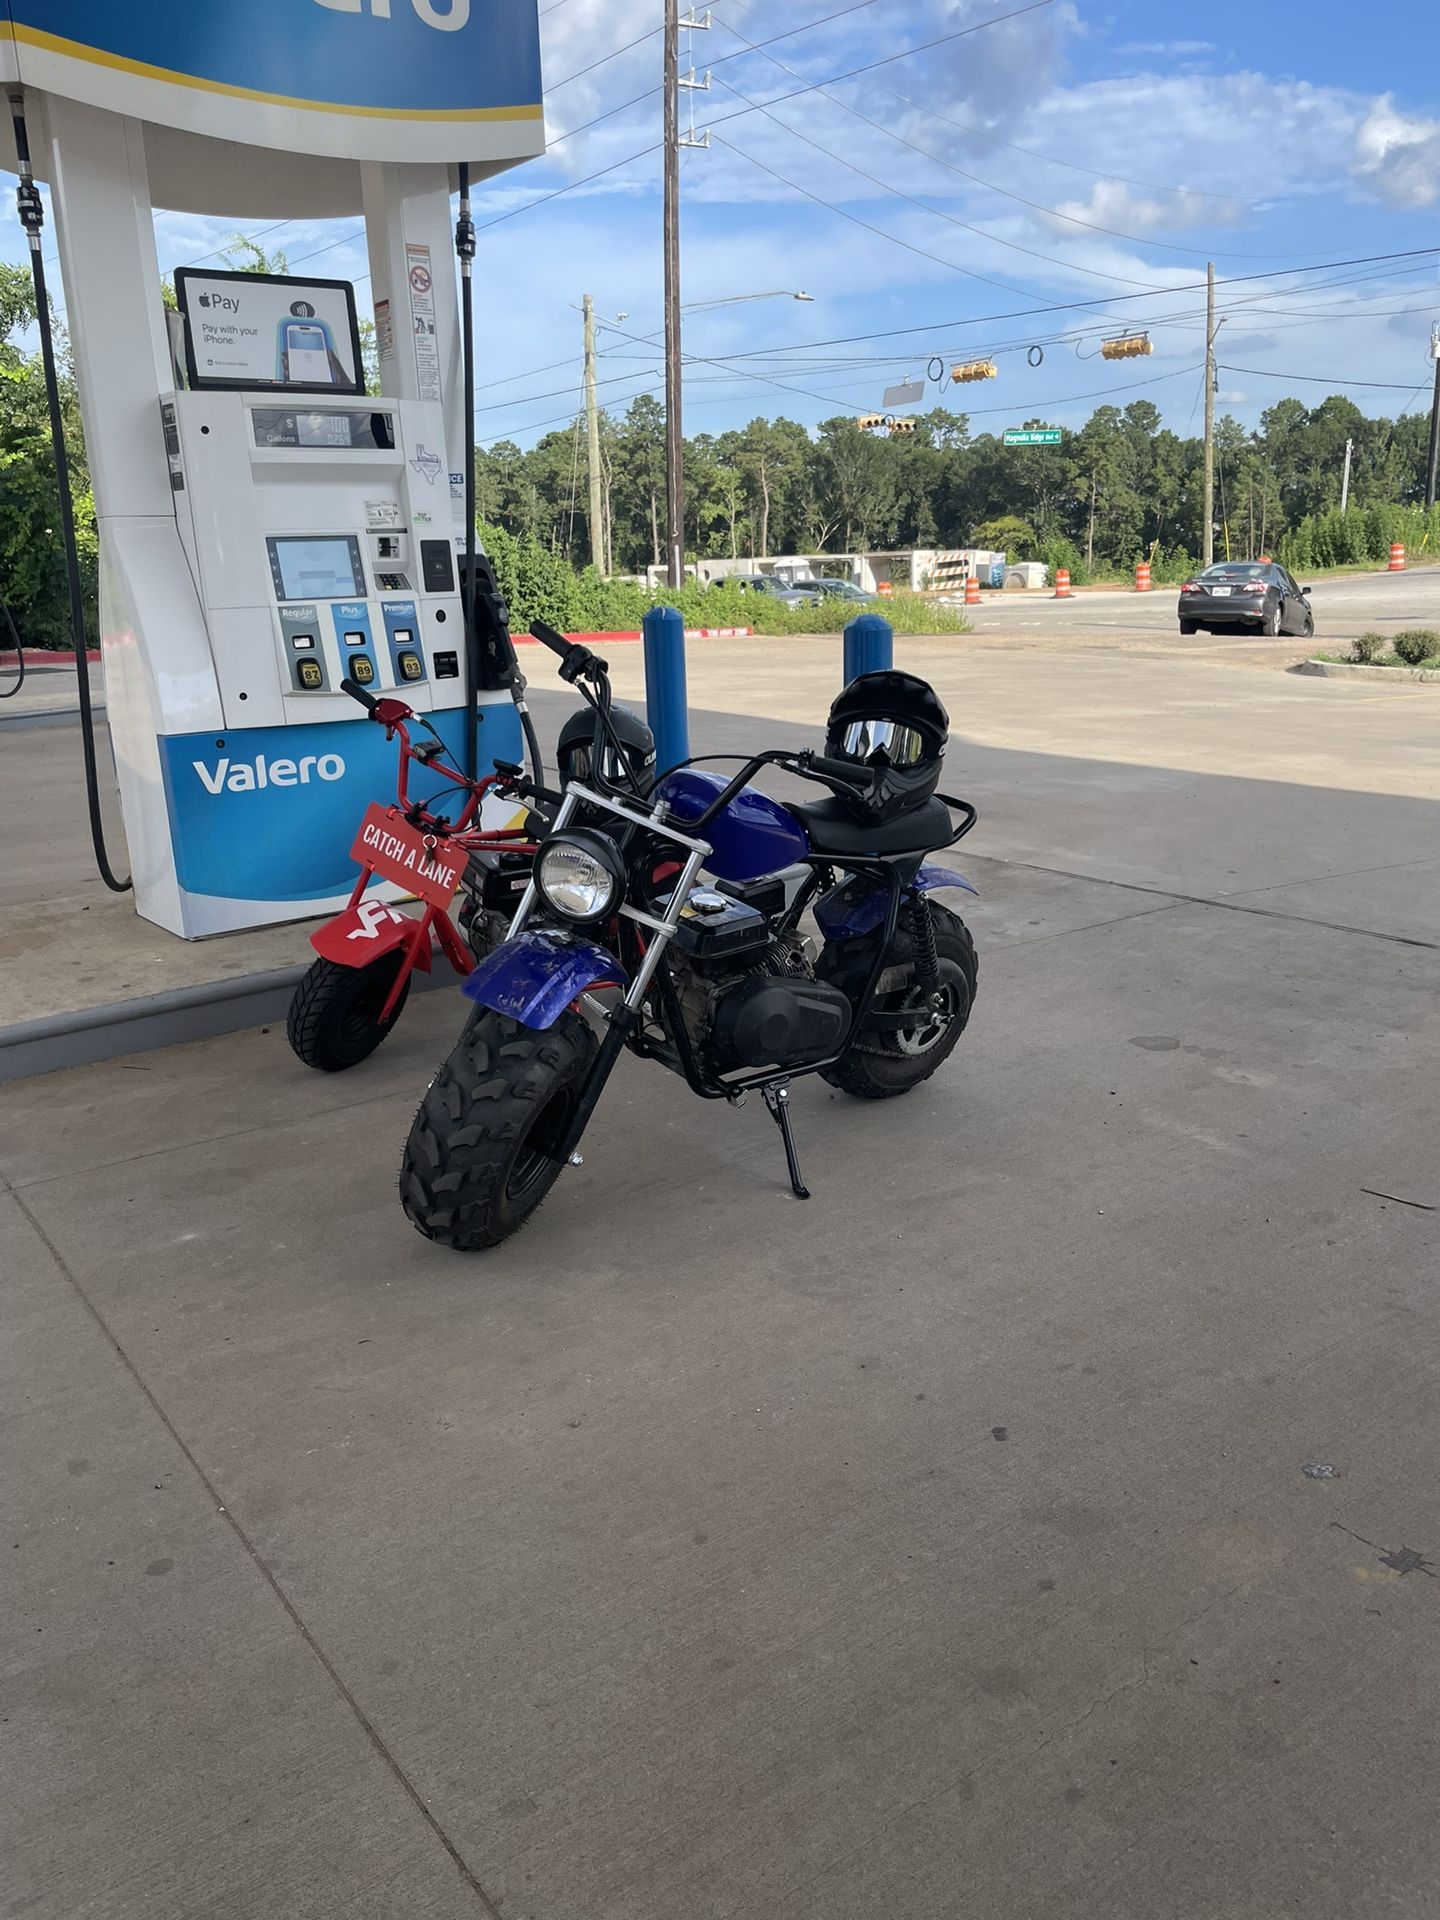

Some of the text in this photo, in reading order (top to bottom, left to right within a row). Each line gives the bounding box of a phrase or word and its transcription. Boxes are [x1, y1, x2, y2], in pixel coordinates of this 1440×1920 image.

[211, 293, 239, 313] Pay
[202, 323, 258, 337] Pay with your
[203, 334, 236, 346] iPhone.
[266, 434, 295, 443] Gallons
[1006, 434, 1029, 443] Magnolia
[1030, 433, 1044, 442] Ridge
[341, 606, 358, 614] Plus
[384, 603, 414, 612] Premium
[282, 608, 313, 619] Regular
[358, 666, 371, 675] 89
[406, 662, 419, 672] 93
[305, 669, 319, 680] 87
[192, 753, 346, 795] Valero
[363, 823, 456, 889] CATCH A LANE
